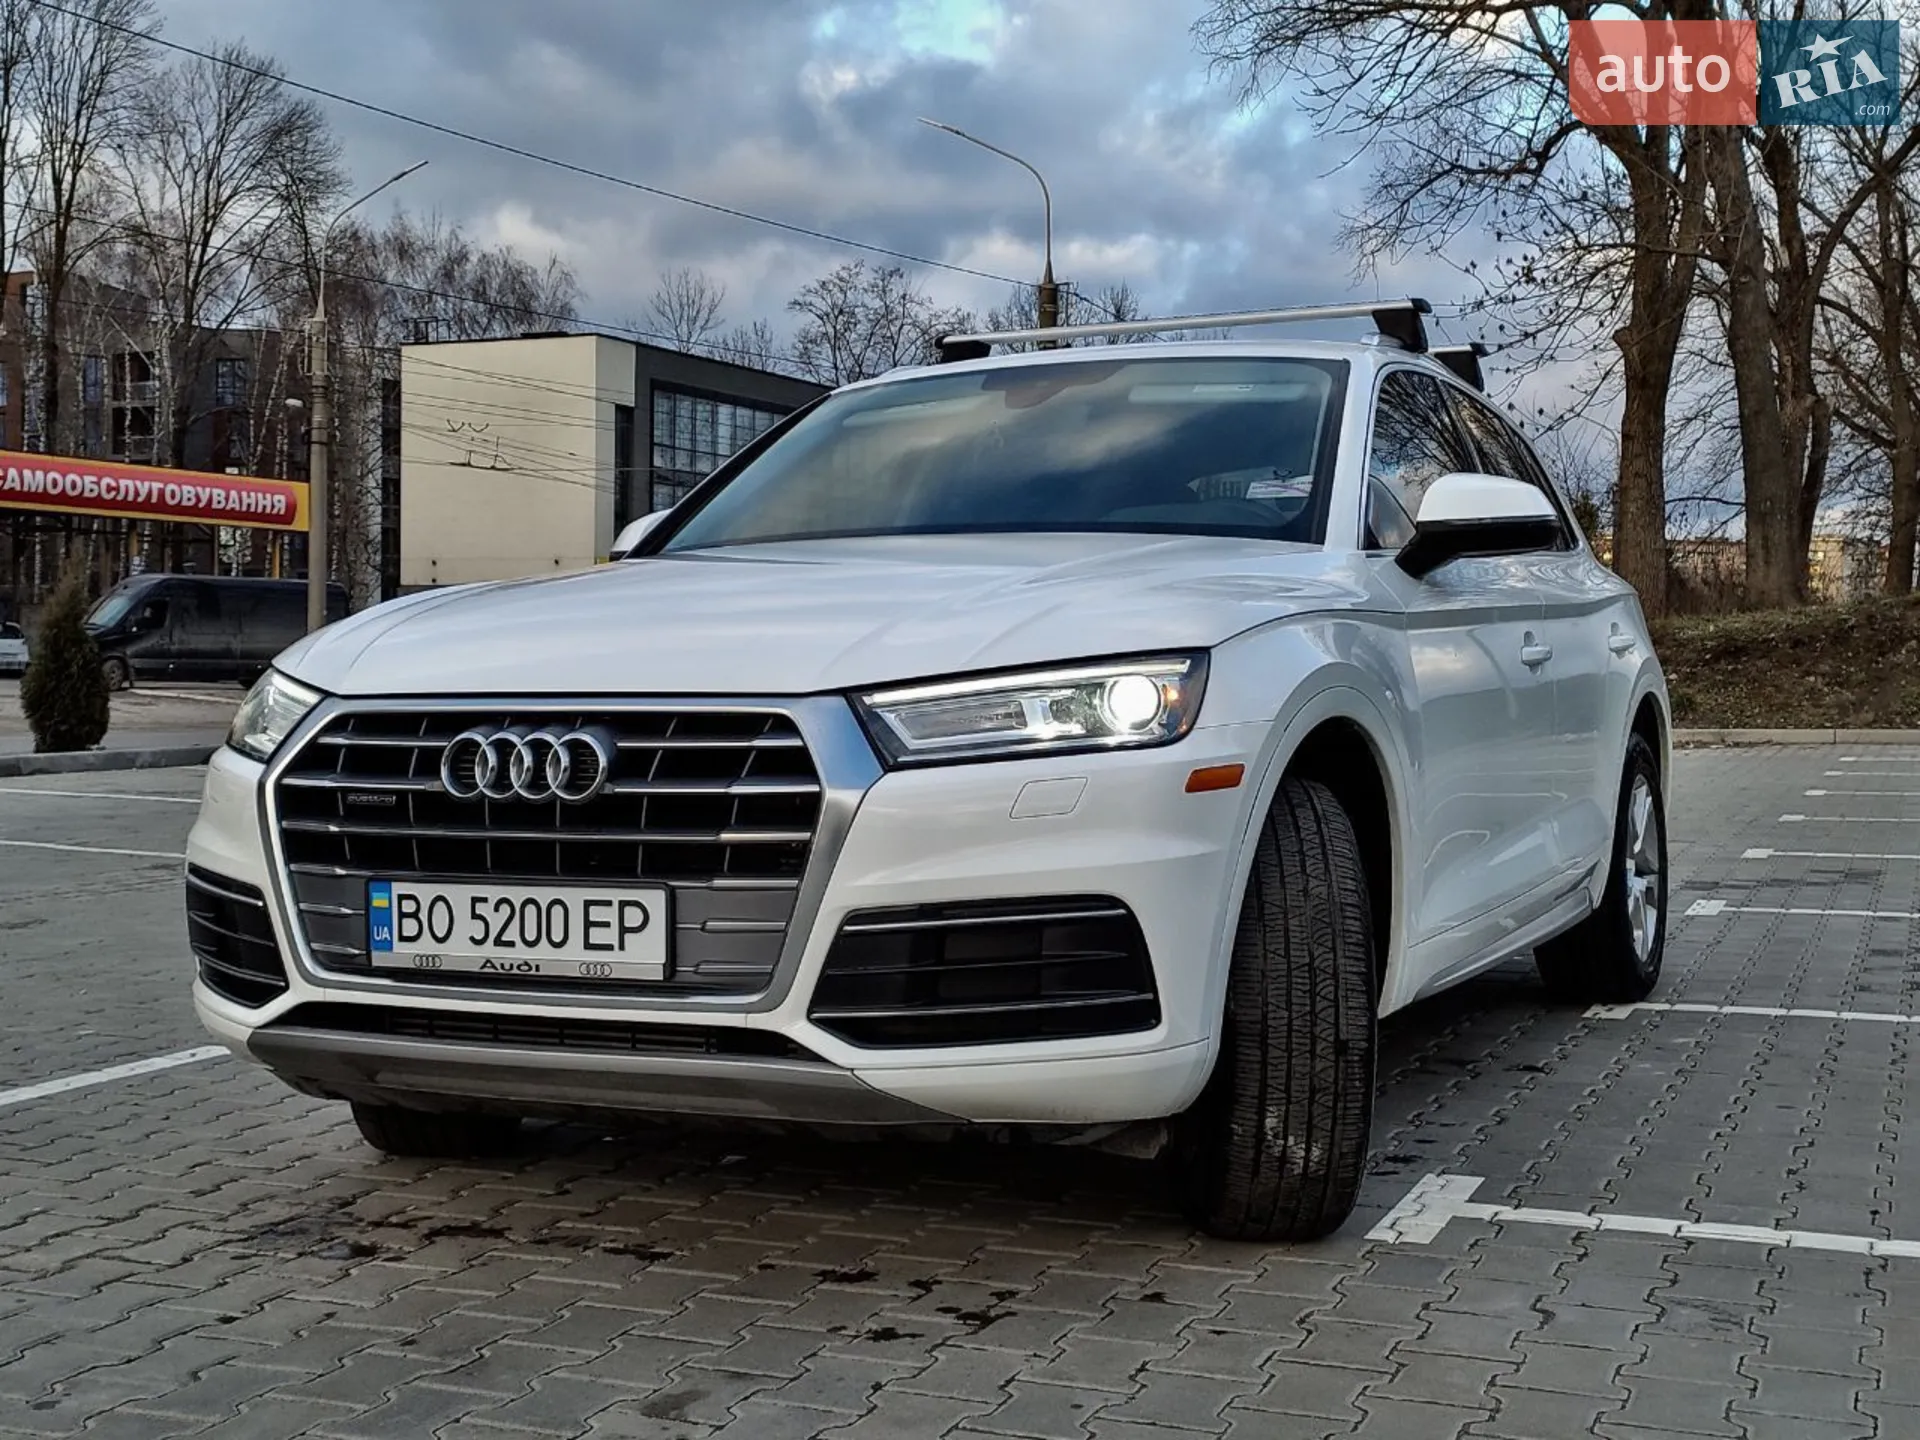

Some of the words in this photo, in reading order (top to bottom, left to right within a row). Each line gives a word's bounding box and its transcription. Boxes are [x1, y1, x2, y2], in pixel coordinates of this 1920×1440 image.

[0, 467, 287, 515] АМООБСЛУГОВУВАННЯ
[374, 925, 391, 941] UA
[397, 893, 454, 944] BO
[468, 896, 570, 948] 5200
[583, 899, 651, 951] EP
[479, 959, 541, 973] Audi
